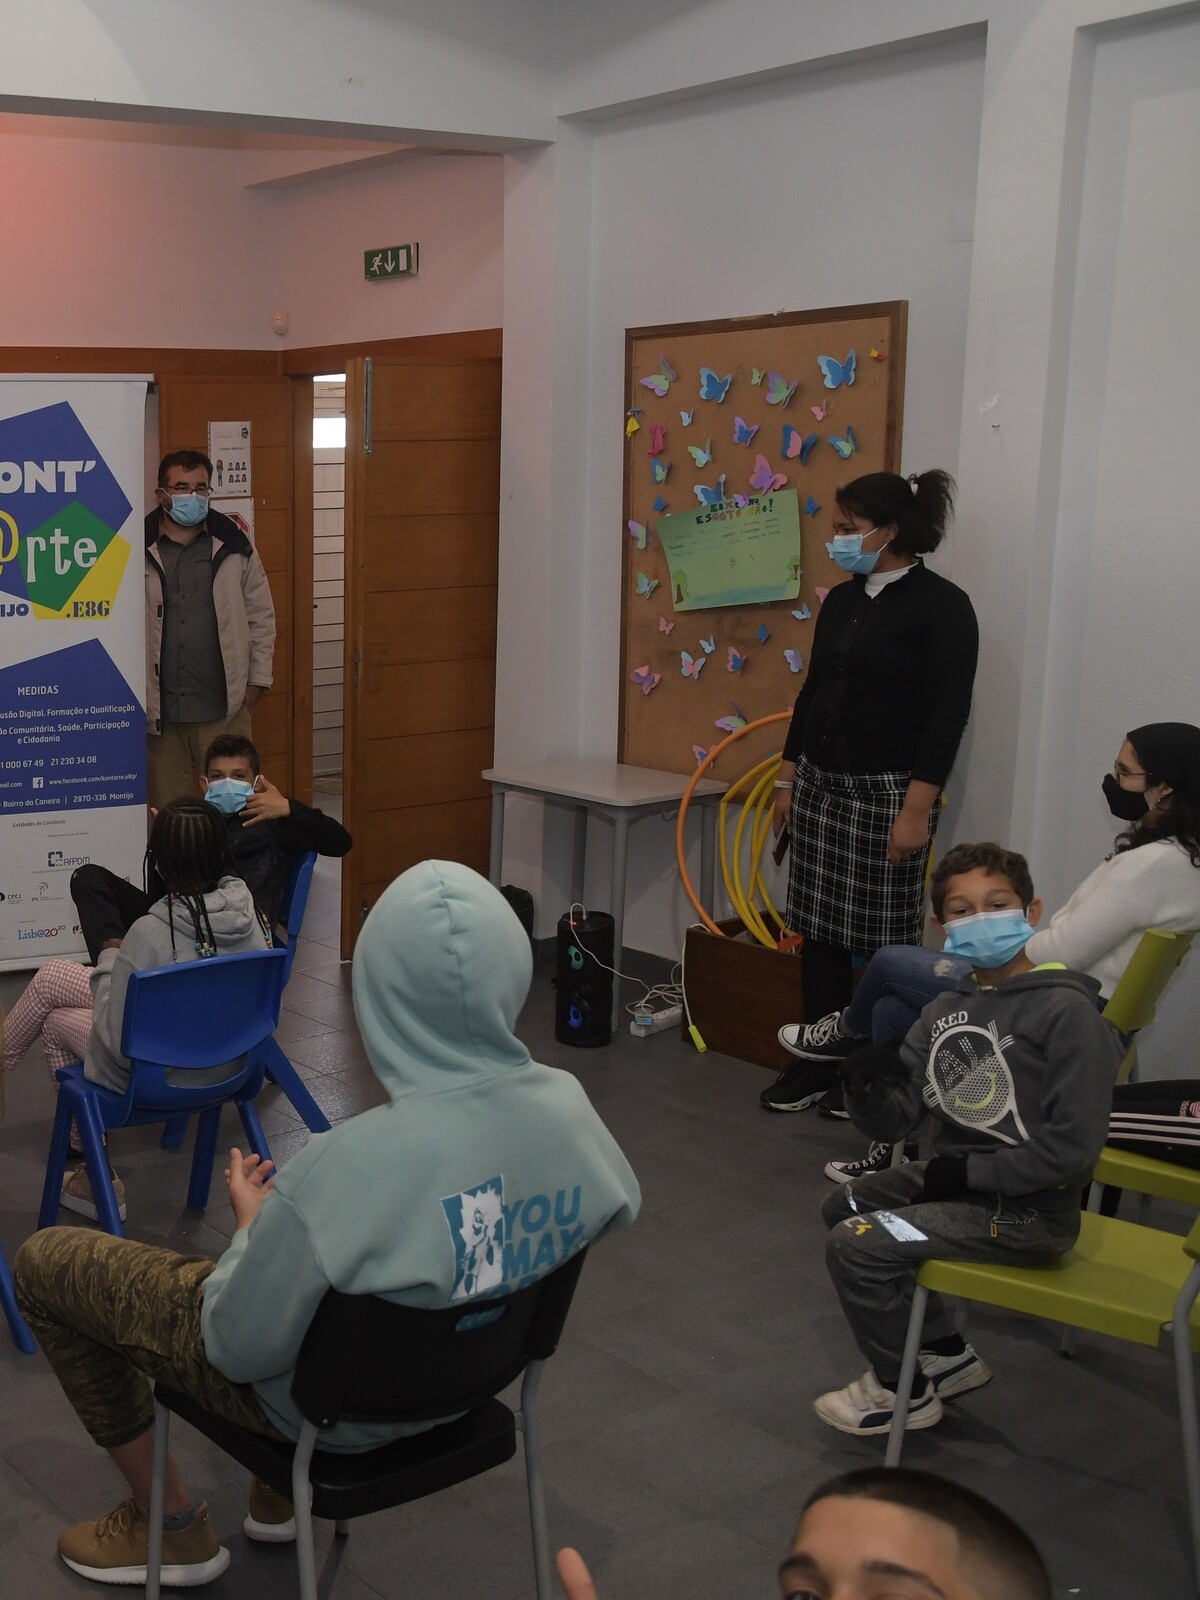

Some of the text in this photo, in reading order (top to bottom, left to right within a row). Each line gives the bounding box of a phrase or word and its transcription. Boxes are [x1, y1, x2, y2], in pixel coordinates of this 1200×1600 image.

[17, 685, 59, 696] MEDIDAS
[19, 708, 46, 720] Digital,
[47, 706, 83, 717] Formação
[90, 704, 135, 715] Qualificação
[8, 724, 56, 736] Comunitária,
[57, 722, 83, 732] Saúde,
[84, 720, 130, 731] Participação
[23, 734, 60, 744] Cidadania
[5, 761, 22, 769] 000
[23, 760, 33, 768] 67
[34, 759, 44, 767] 49
[51, 755, 97, 766] 21 230 34 08
[3, 799, 23, 808] Bairro
[24, 798, 34, 807] da
[35, 797, 61, 806] Caneira
[73, 793, 107, 803] 2870-336
[109, 791, 134, 801] Montijo
[501, 1185, 581, 1241] YOU
[501, 1223, 586, 1284] MAY
